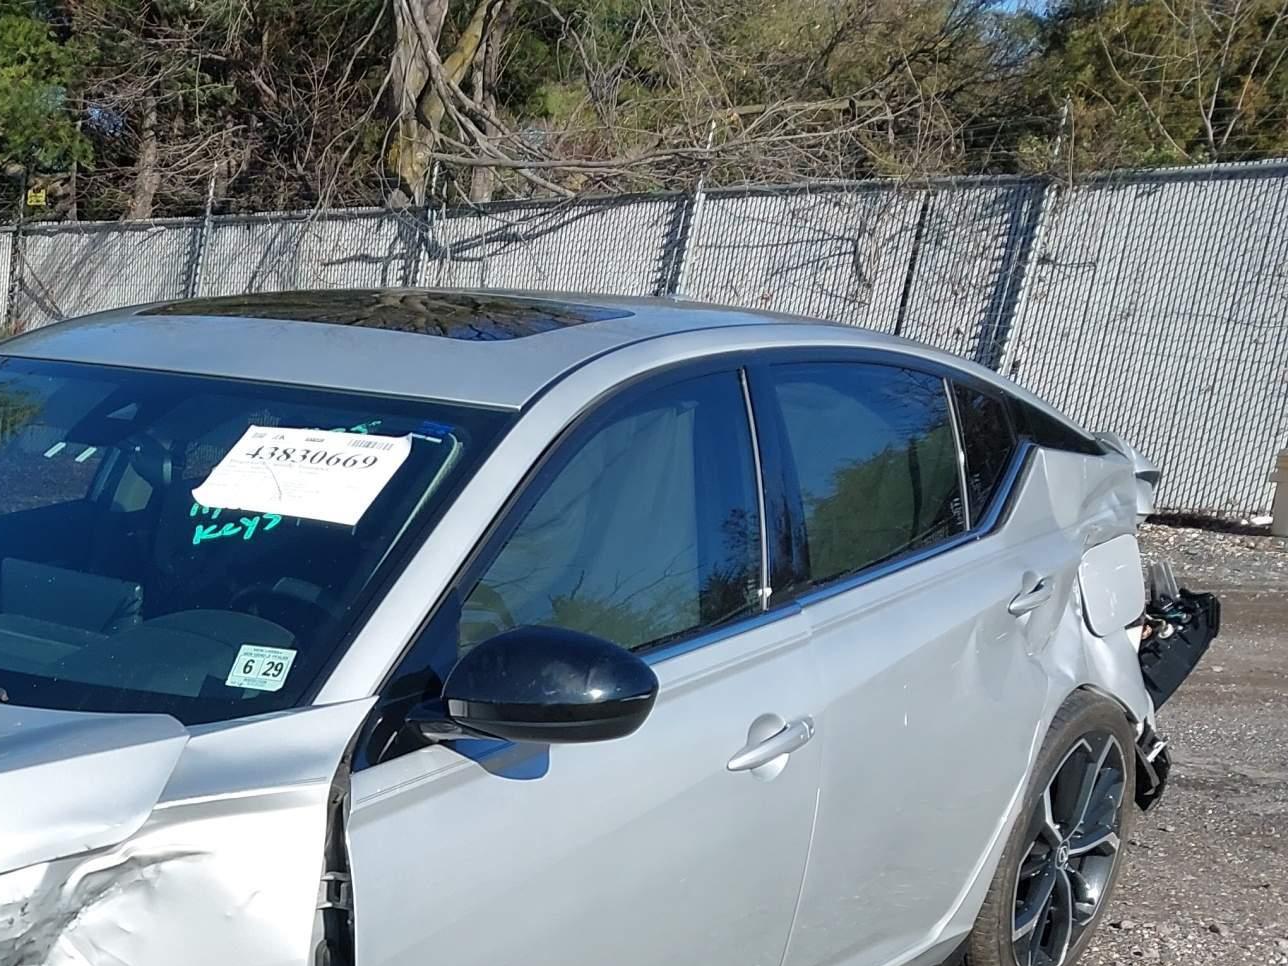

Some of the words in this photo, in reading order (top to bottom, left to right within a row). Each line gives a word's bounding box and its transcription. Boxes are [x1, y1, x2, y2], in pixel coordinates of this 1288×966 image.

[245, 445, 379, 470] 43830669
[243, 659, 255, 674] 6
[262, 661, 284, 677] 29
